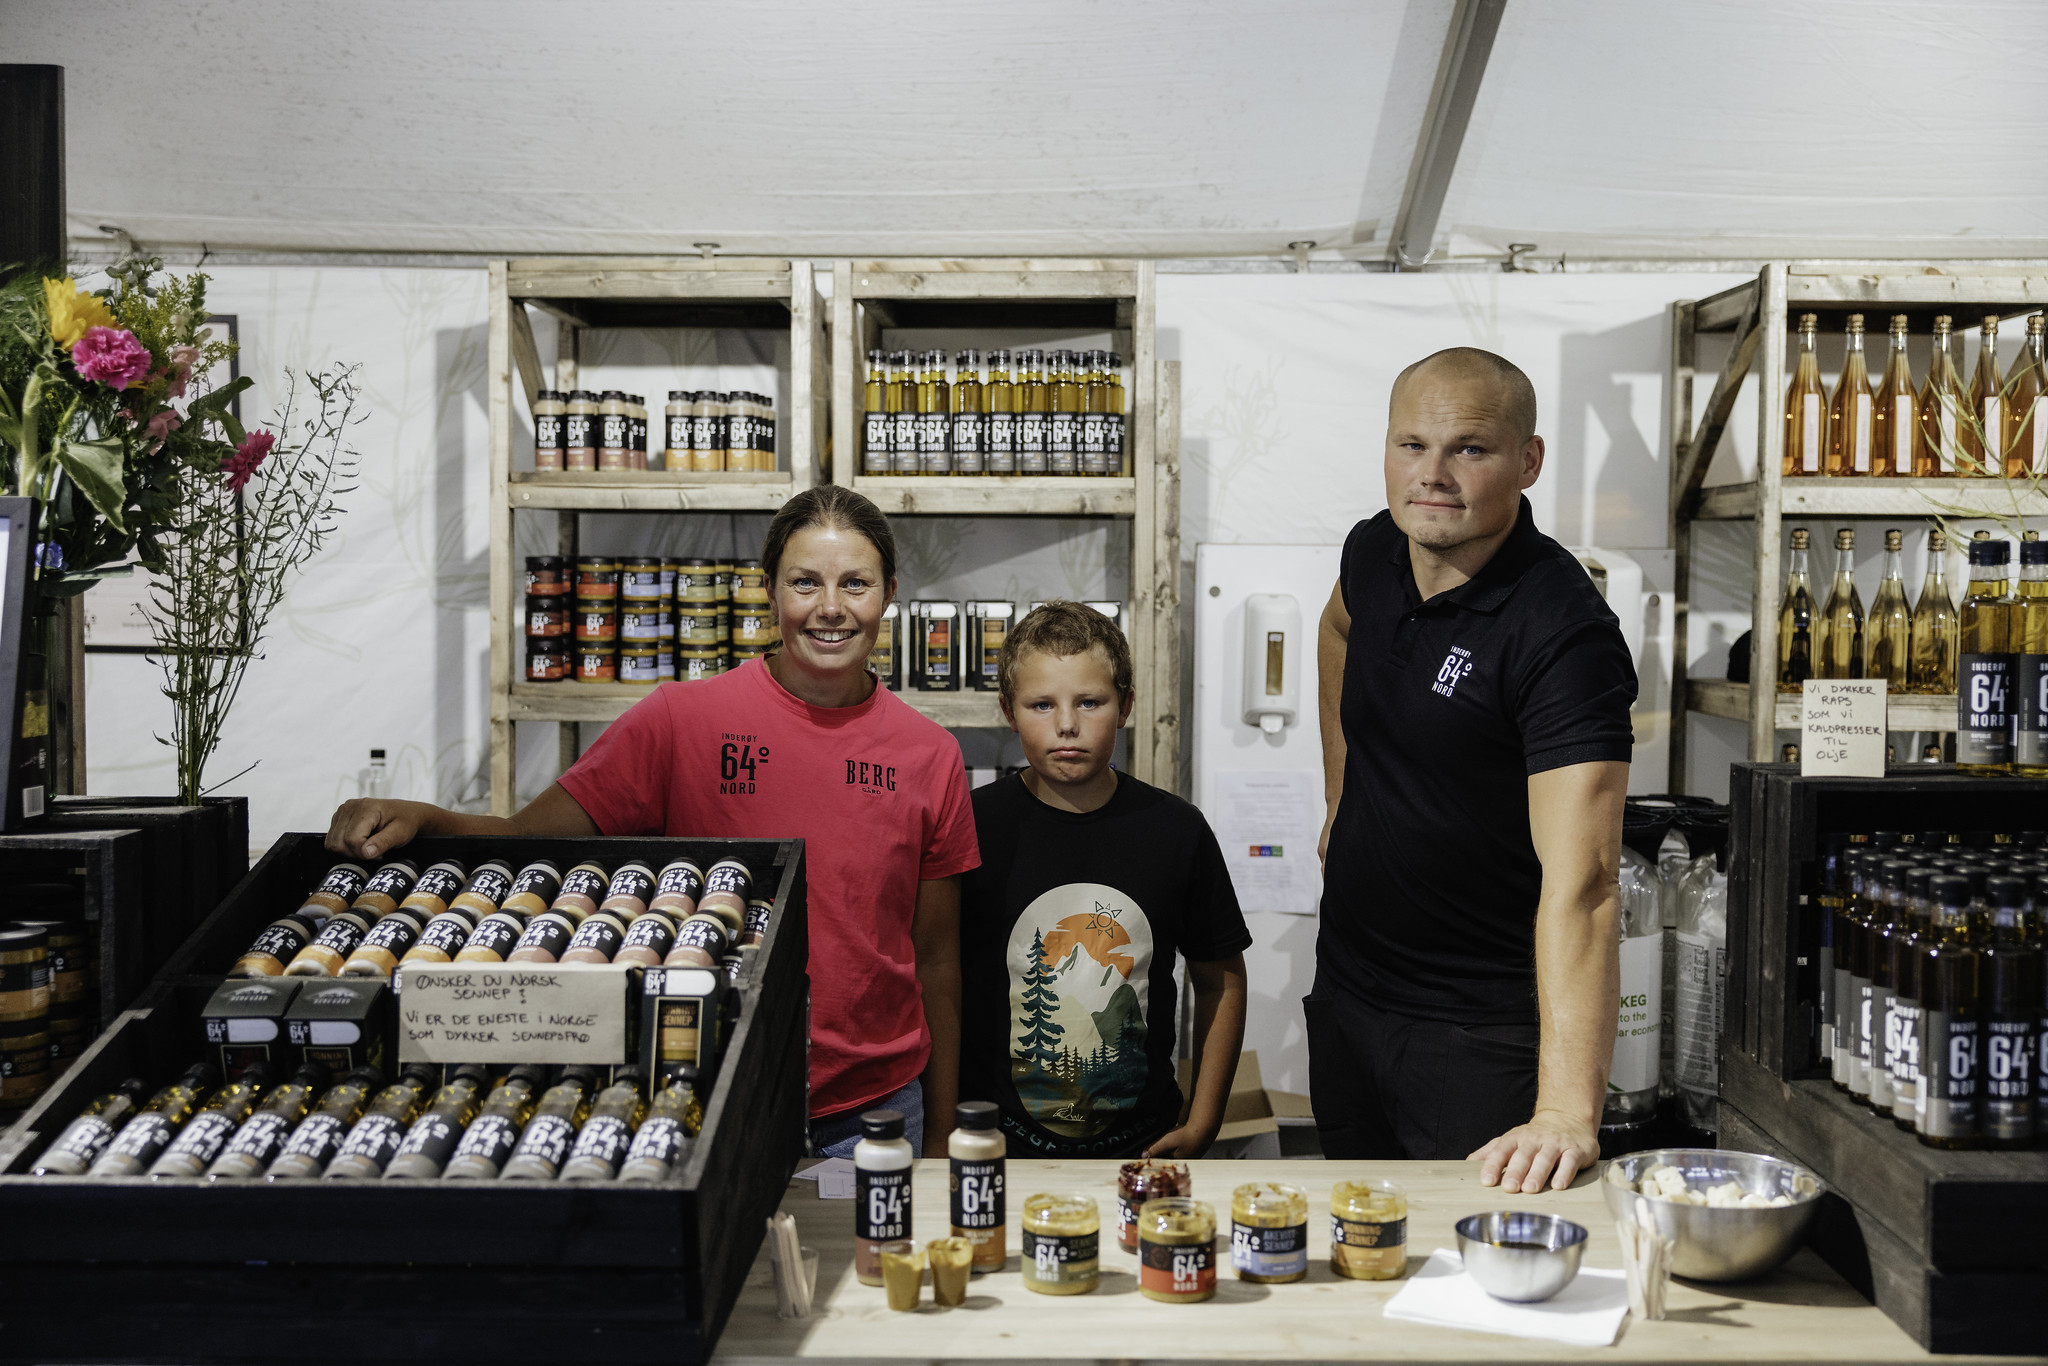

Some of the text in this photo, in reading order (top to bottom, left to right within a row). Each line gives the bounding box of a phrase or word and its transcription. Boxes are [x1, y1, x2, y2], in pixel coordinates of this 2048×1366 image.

[1432, 681, 1454, 697] NORD
[1832, 685, 1876, 695] DYRKER
[1822, 696, 1852, 706] RAPS
[1808, 710, 1830, 720] SOM
[1970, 714, 2004, 727] NORD
[1808, 724, 1882, 736] KALDPRESSER
[722, 732, 758, 743] INDERØY
[1824, 737, 1848, 746] TIL
[846, 760, 896, 792] BERG
[720, 782, 756, 794] NORD
[416, 973, 562, 990] ØNSKER DU NORSK
[1620, 994, 1646, 1008] KEG
[426, 1014, 446, 1026] ER
[452, 1014, 470, 1025] DE
[478, 1013, 528, 1026] ENESTE
[550, 1013, 598, 1026] NORGE
[1620, 1012, 1646, 1022] to the
[408, 1030, 434, 1040] SOM
[446, 1030, 500, 1042] DYRKER
[962, 1213, 995, 1226] NORD
[870, 1224, 902, 1238] NORD
